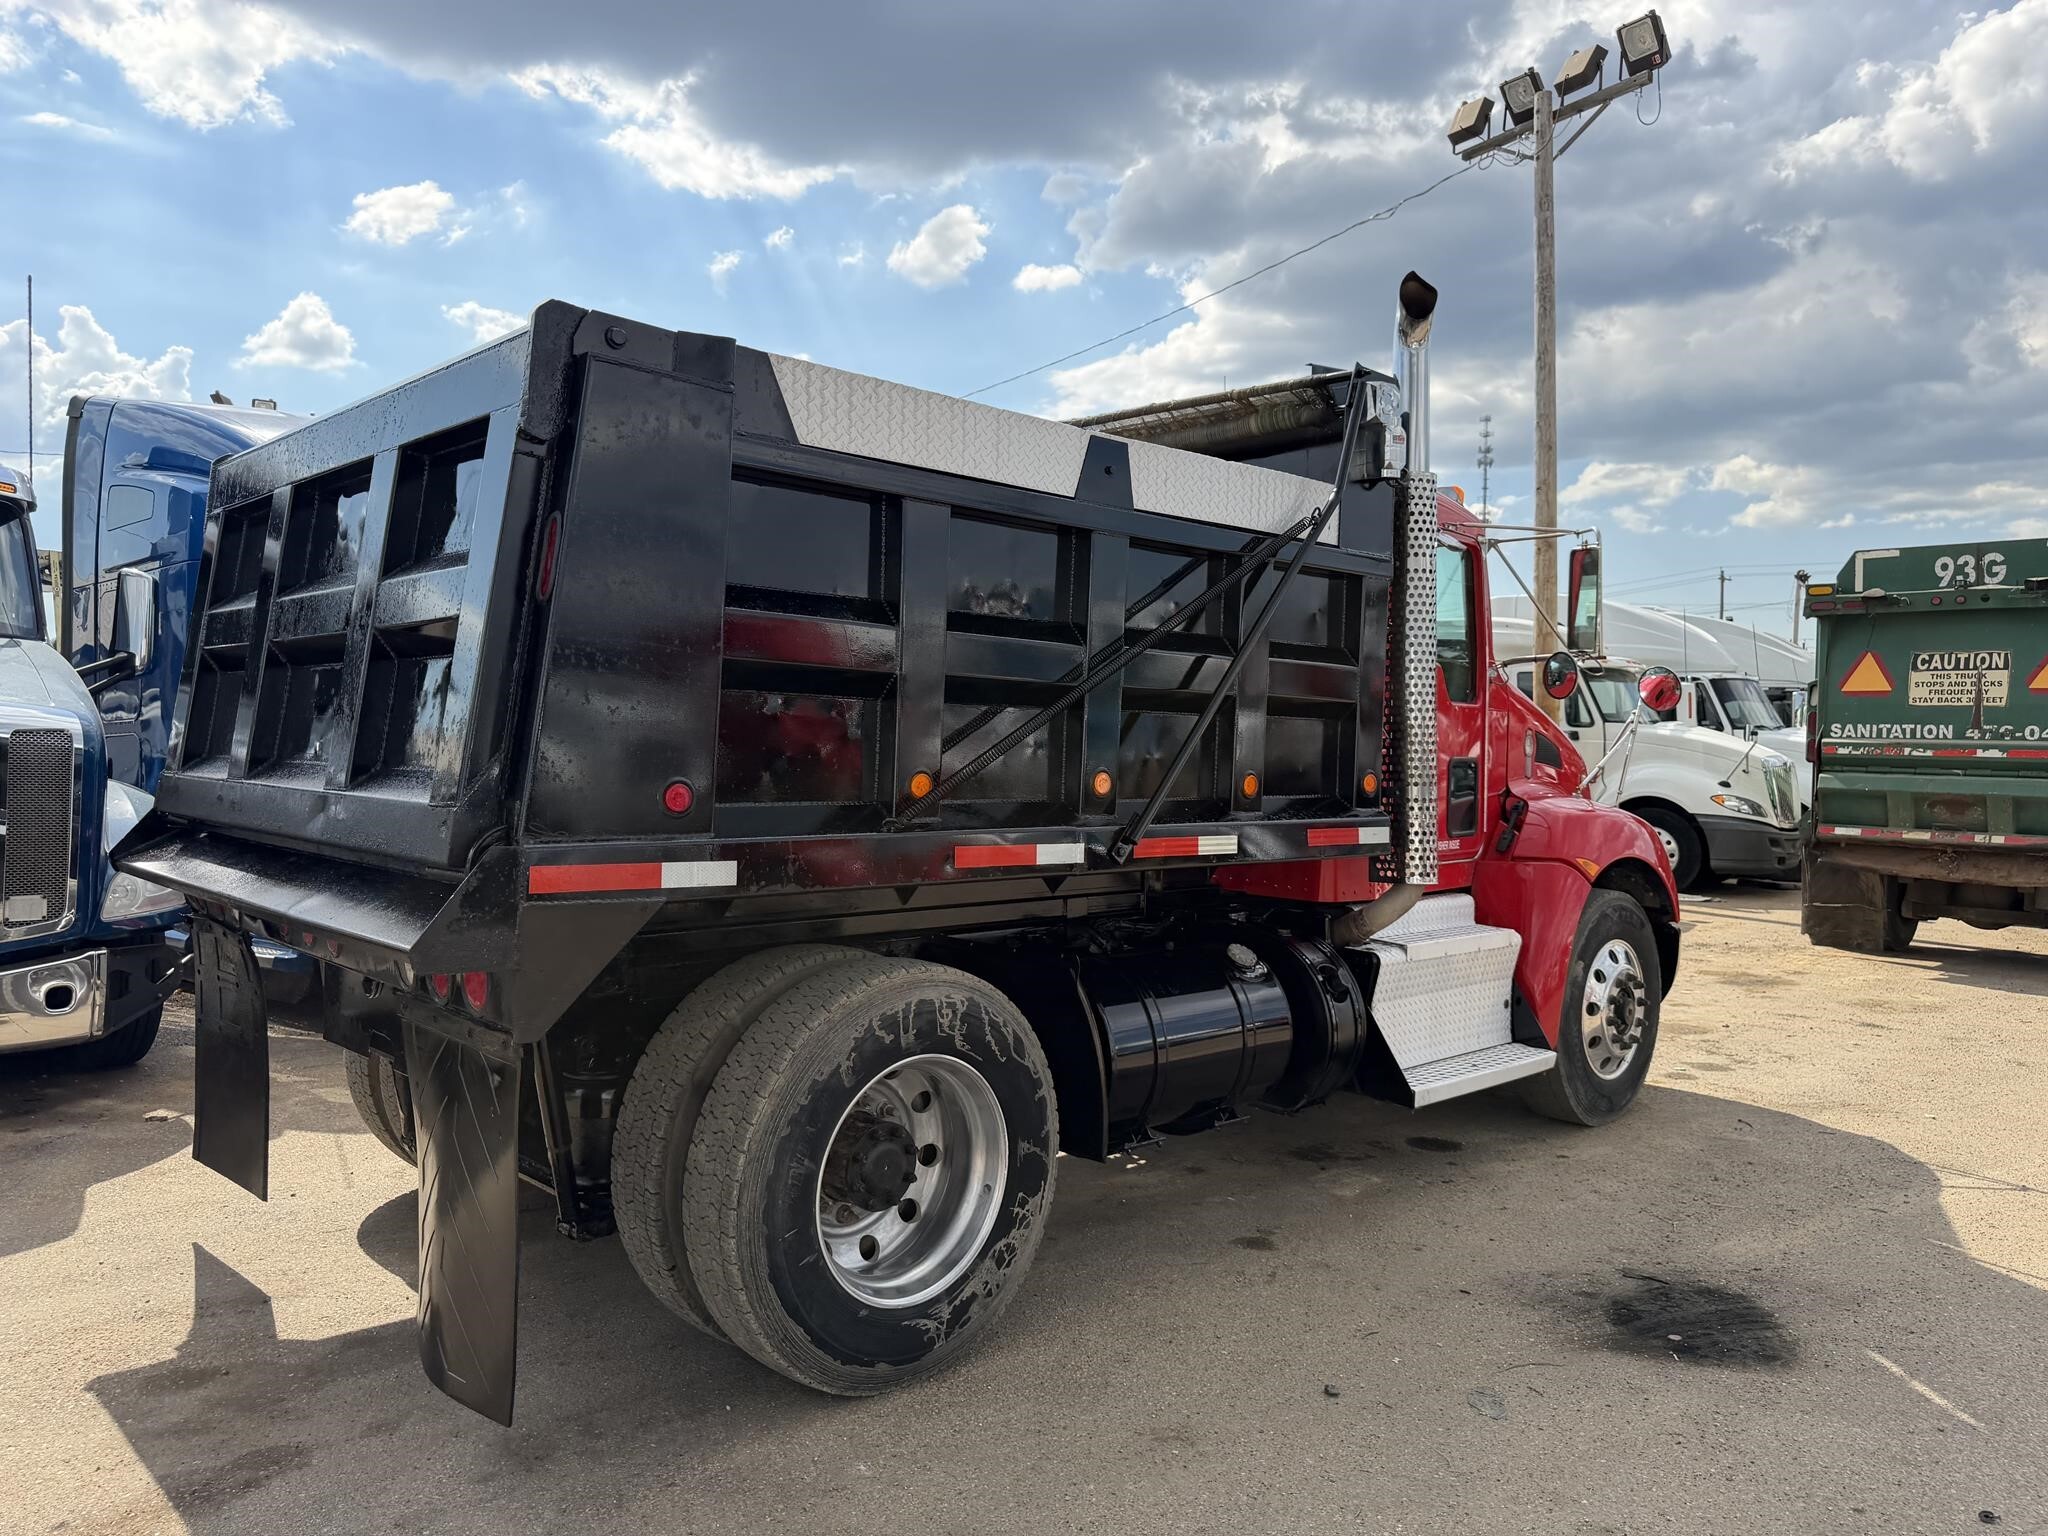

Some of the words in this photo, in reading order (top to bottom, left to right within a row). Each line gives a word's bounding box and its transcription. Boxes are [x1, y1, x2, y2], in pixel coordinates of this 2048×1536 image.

[1934, 552, 2007, 587] 93G
[1916, 652, 2004, 670] CAUTION
[1970, 680, 2003, 688] BCKS
[1928, 688, 1990, 696] FREQUENY
[1911, 696, 1935, 704] STAY
[1937, 696, 1963, 704] BACK
[1830, 723, 1953, 739] SANITATION
